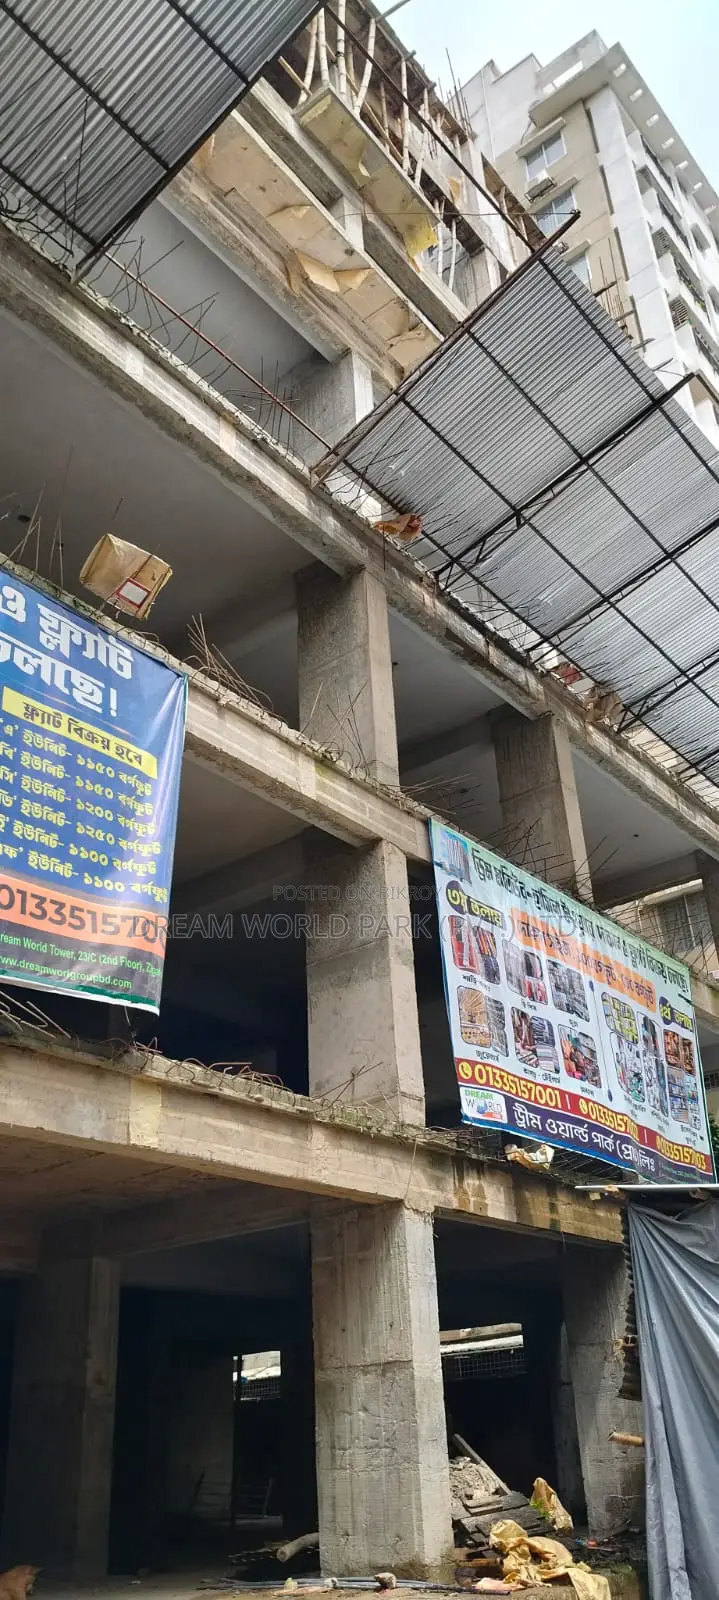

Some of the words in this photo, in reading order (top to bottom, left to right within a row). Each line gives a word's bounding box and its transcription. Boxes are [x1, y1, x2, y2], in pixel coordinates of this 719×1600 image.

[38, 603, 133, 679] ফ্ল্যাট
[23, 702, 62, 729] ফ্ল্যাট
[67, 719, 110, 750] বিক্রয়
[115, 743, 143, 766] হবে
[23, 729, 72, 757] ইউনিট-
[77, 754, 115, 778] ১১৫০
[20, 751, 71, 778] ইউনিট-
[75, 776, 114, 799] ১১৫০
[20, 775, 71, 803] ইউনিট-
[76, 799, 114, 821] ১২০০
[12, 819, 65, 848] ইউনিট-
[69, 844, 109, 866] ১১০০
[20, 798, 72, 827] ইউনিট-
[76, 822, 115, 846] ১২৫০
[28, 850, 79, 878] ইউনিট-
[84, 872, 125, 893] ১১০০
[0, 934, 21, 946] ream
[23, 938, 47, 953] World
[50, 944, 75, 962] Tower,
[78, 951, 97, 962] 23/C
[99, 953, 118, 966] (2nd
[464, 1089, 494, 1100] DREAM
[474, 1063, 562, 1109] 01335157001
[545, 1119, 589, 1143] ওয়ার্ল্ড
[591, 1124, 615, 1152] পার্ক
